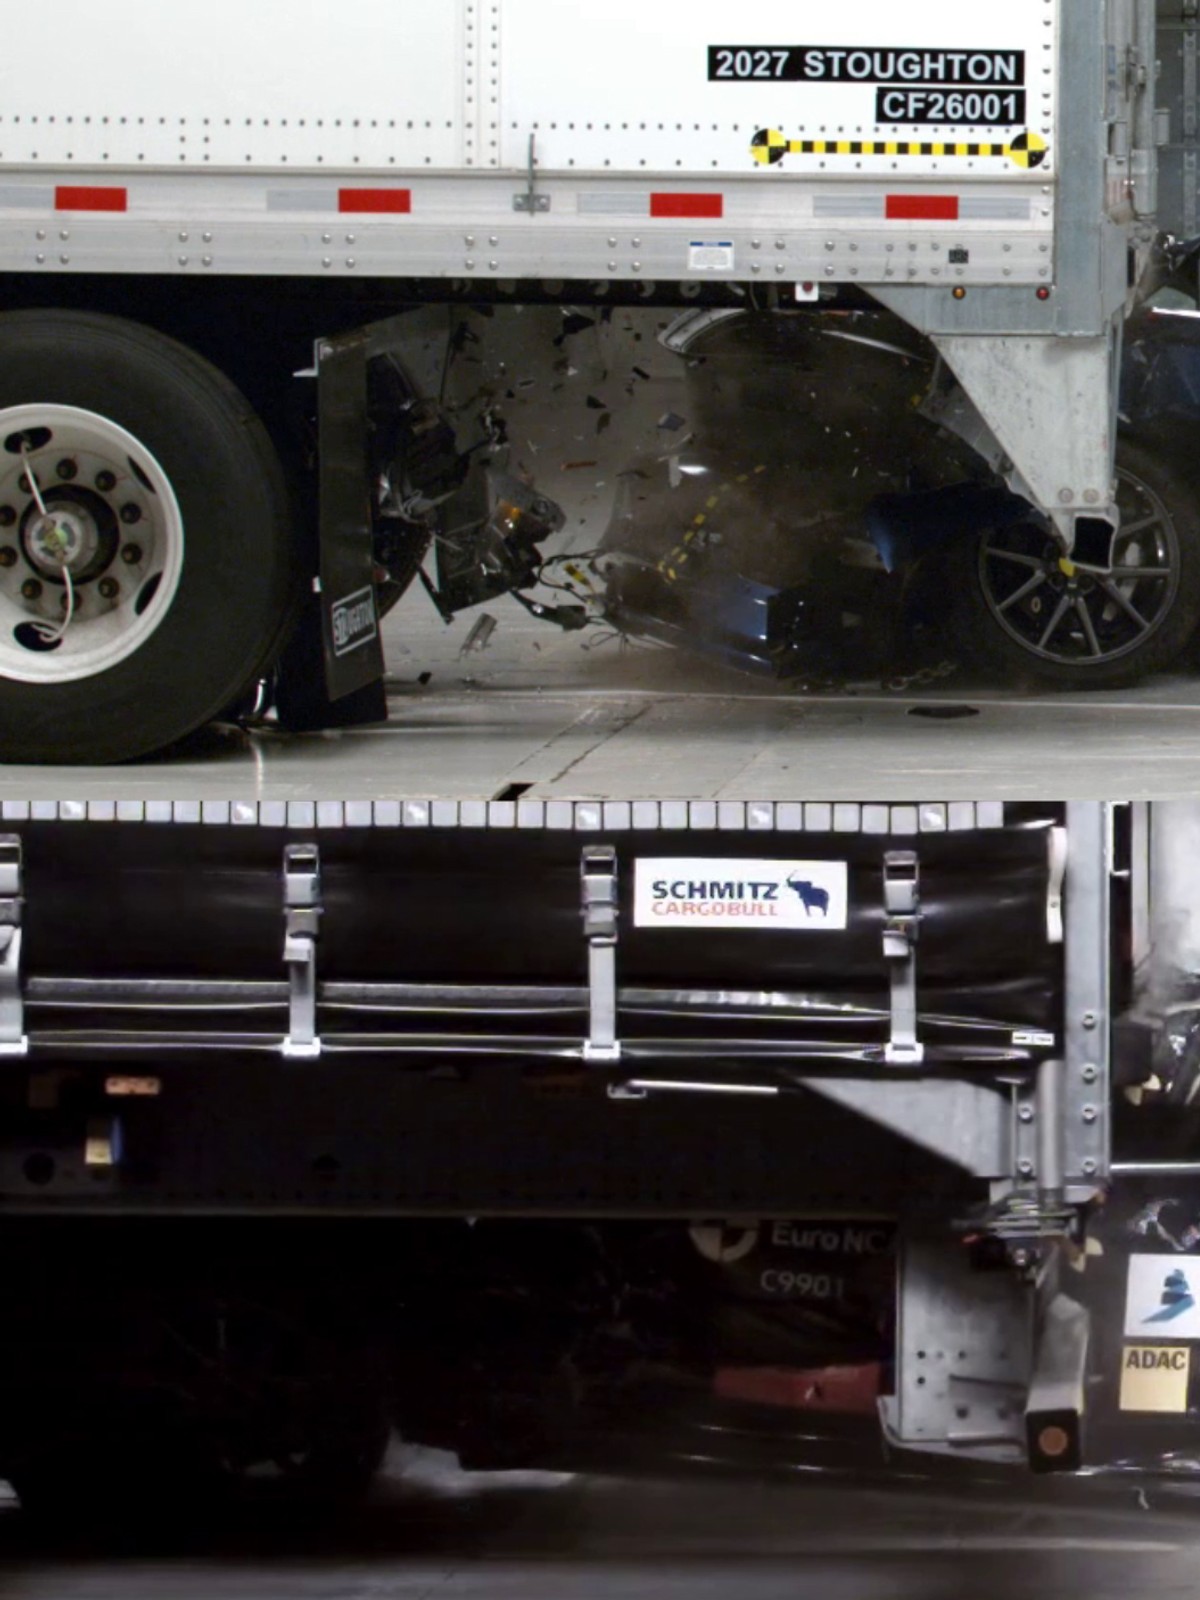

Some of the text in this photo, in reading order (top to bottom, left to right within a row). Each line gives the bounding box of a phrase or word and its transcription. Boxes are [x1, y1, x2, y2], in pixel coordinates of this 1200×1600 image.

[716, 51, 1016, 81] 2027 STOUGHTON
[882, 91, 1016, 120] CF26001
[652, 880, 779, 900] SCHMITZ
[651, 901, 778, 917] CARGOBULL
[771, 1222, 840, 1250] Euro
[760, 1268, 844, 1297] C9901
[1126, 1350, 1187, 1370] ADAC
